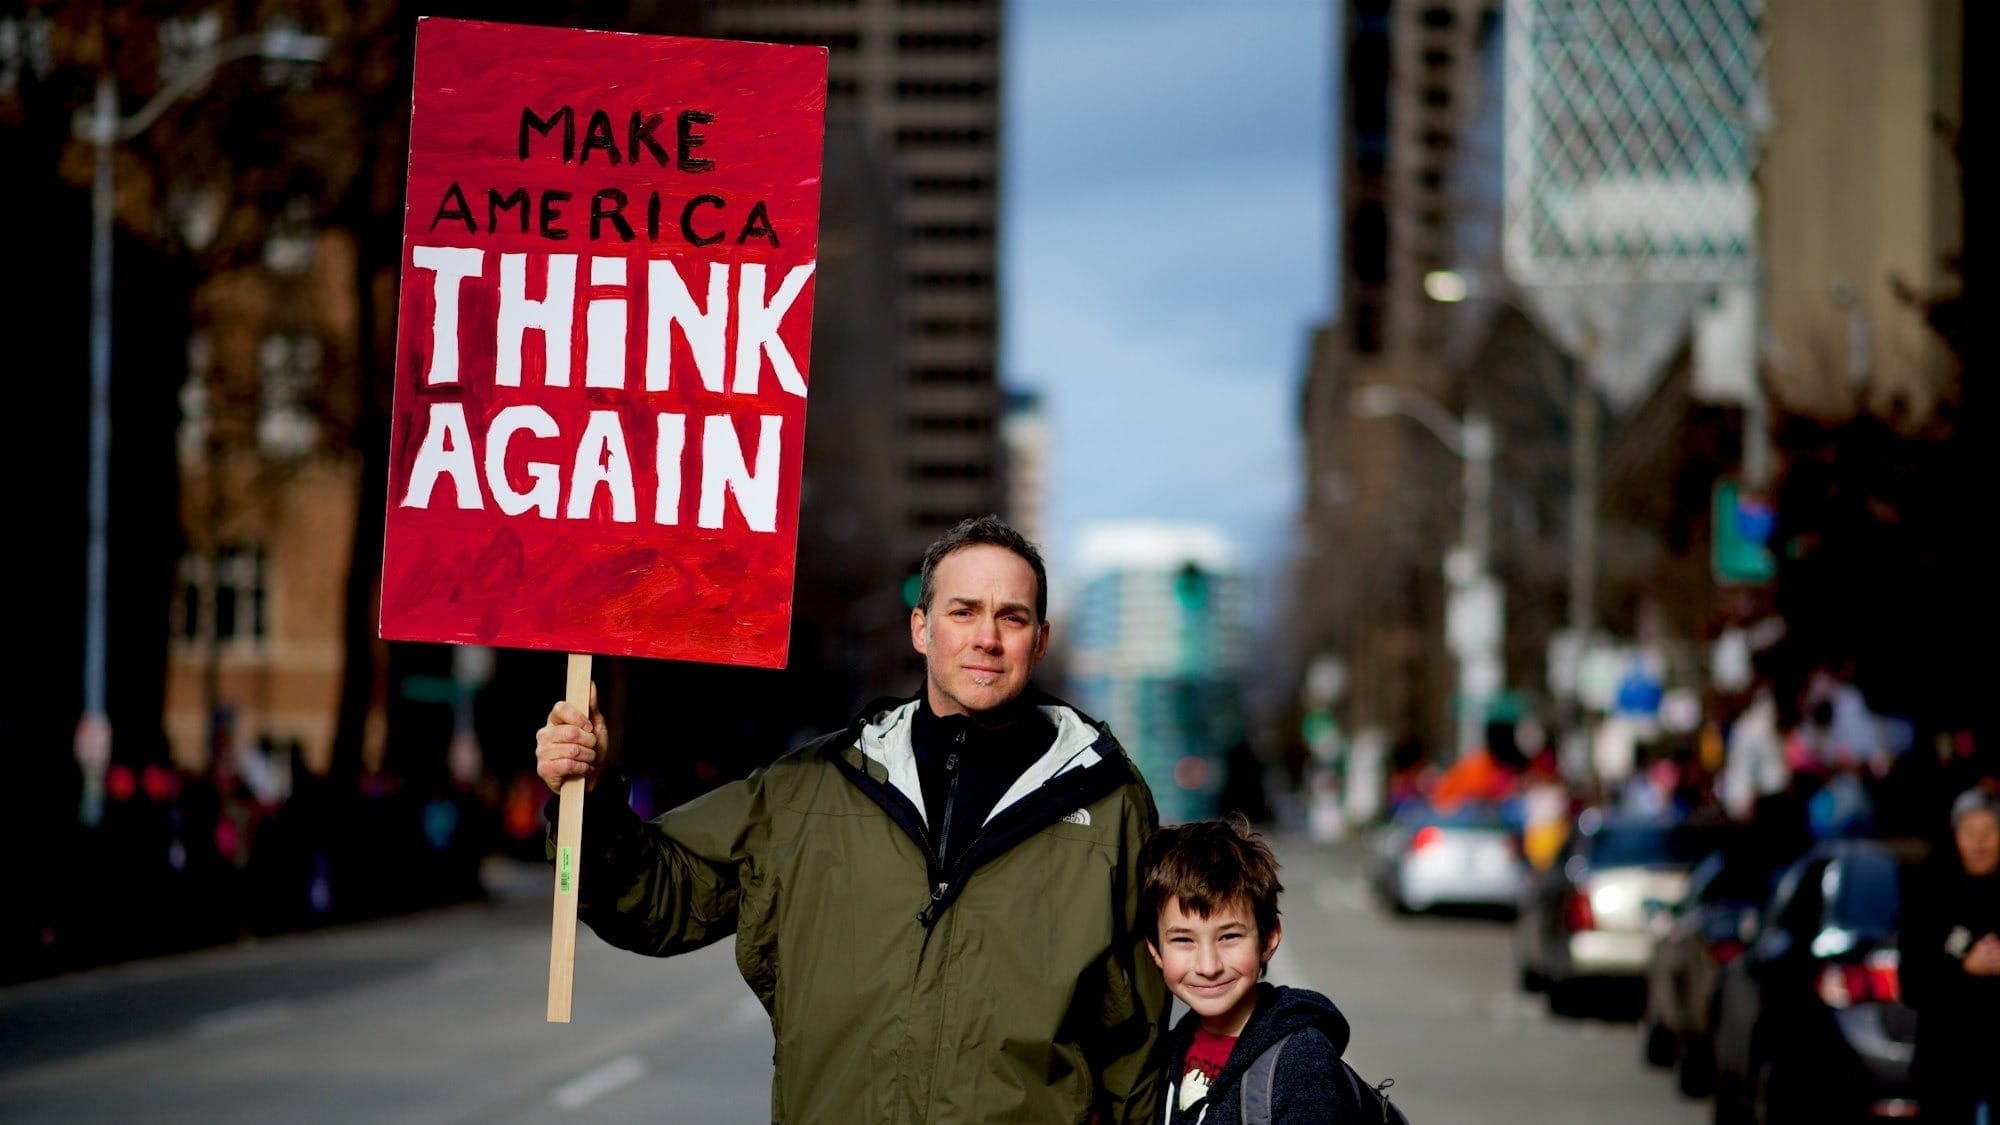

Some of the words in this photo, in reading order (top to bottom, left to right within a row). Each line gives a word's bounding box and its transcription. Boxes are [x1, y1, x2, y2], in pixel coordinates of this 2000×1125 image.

[517, 104, 715, 173] MAKE
[430, 181, 780, 248] AMERICA
[400, 402, 783, 533] AGAIN
